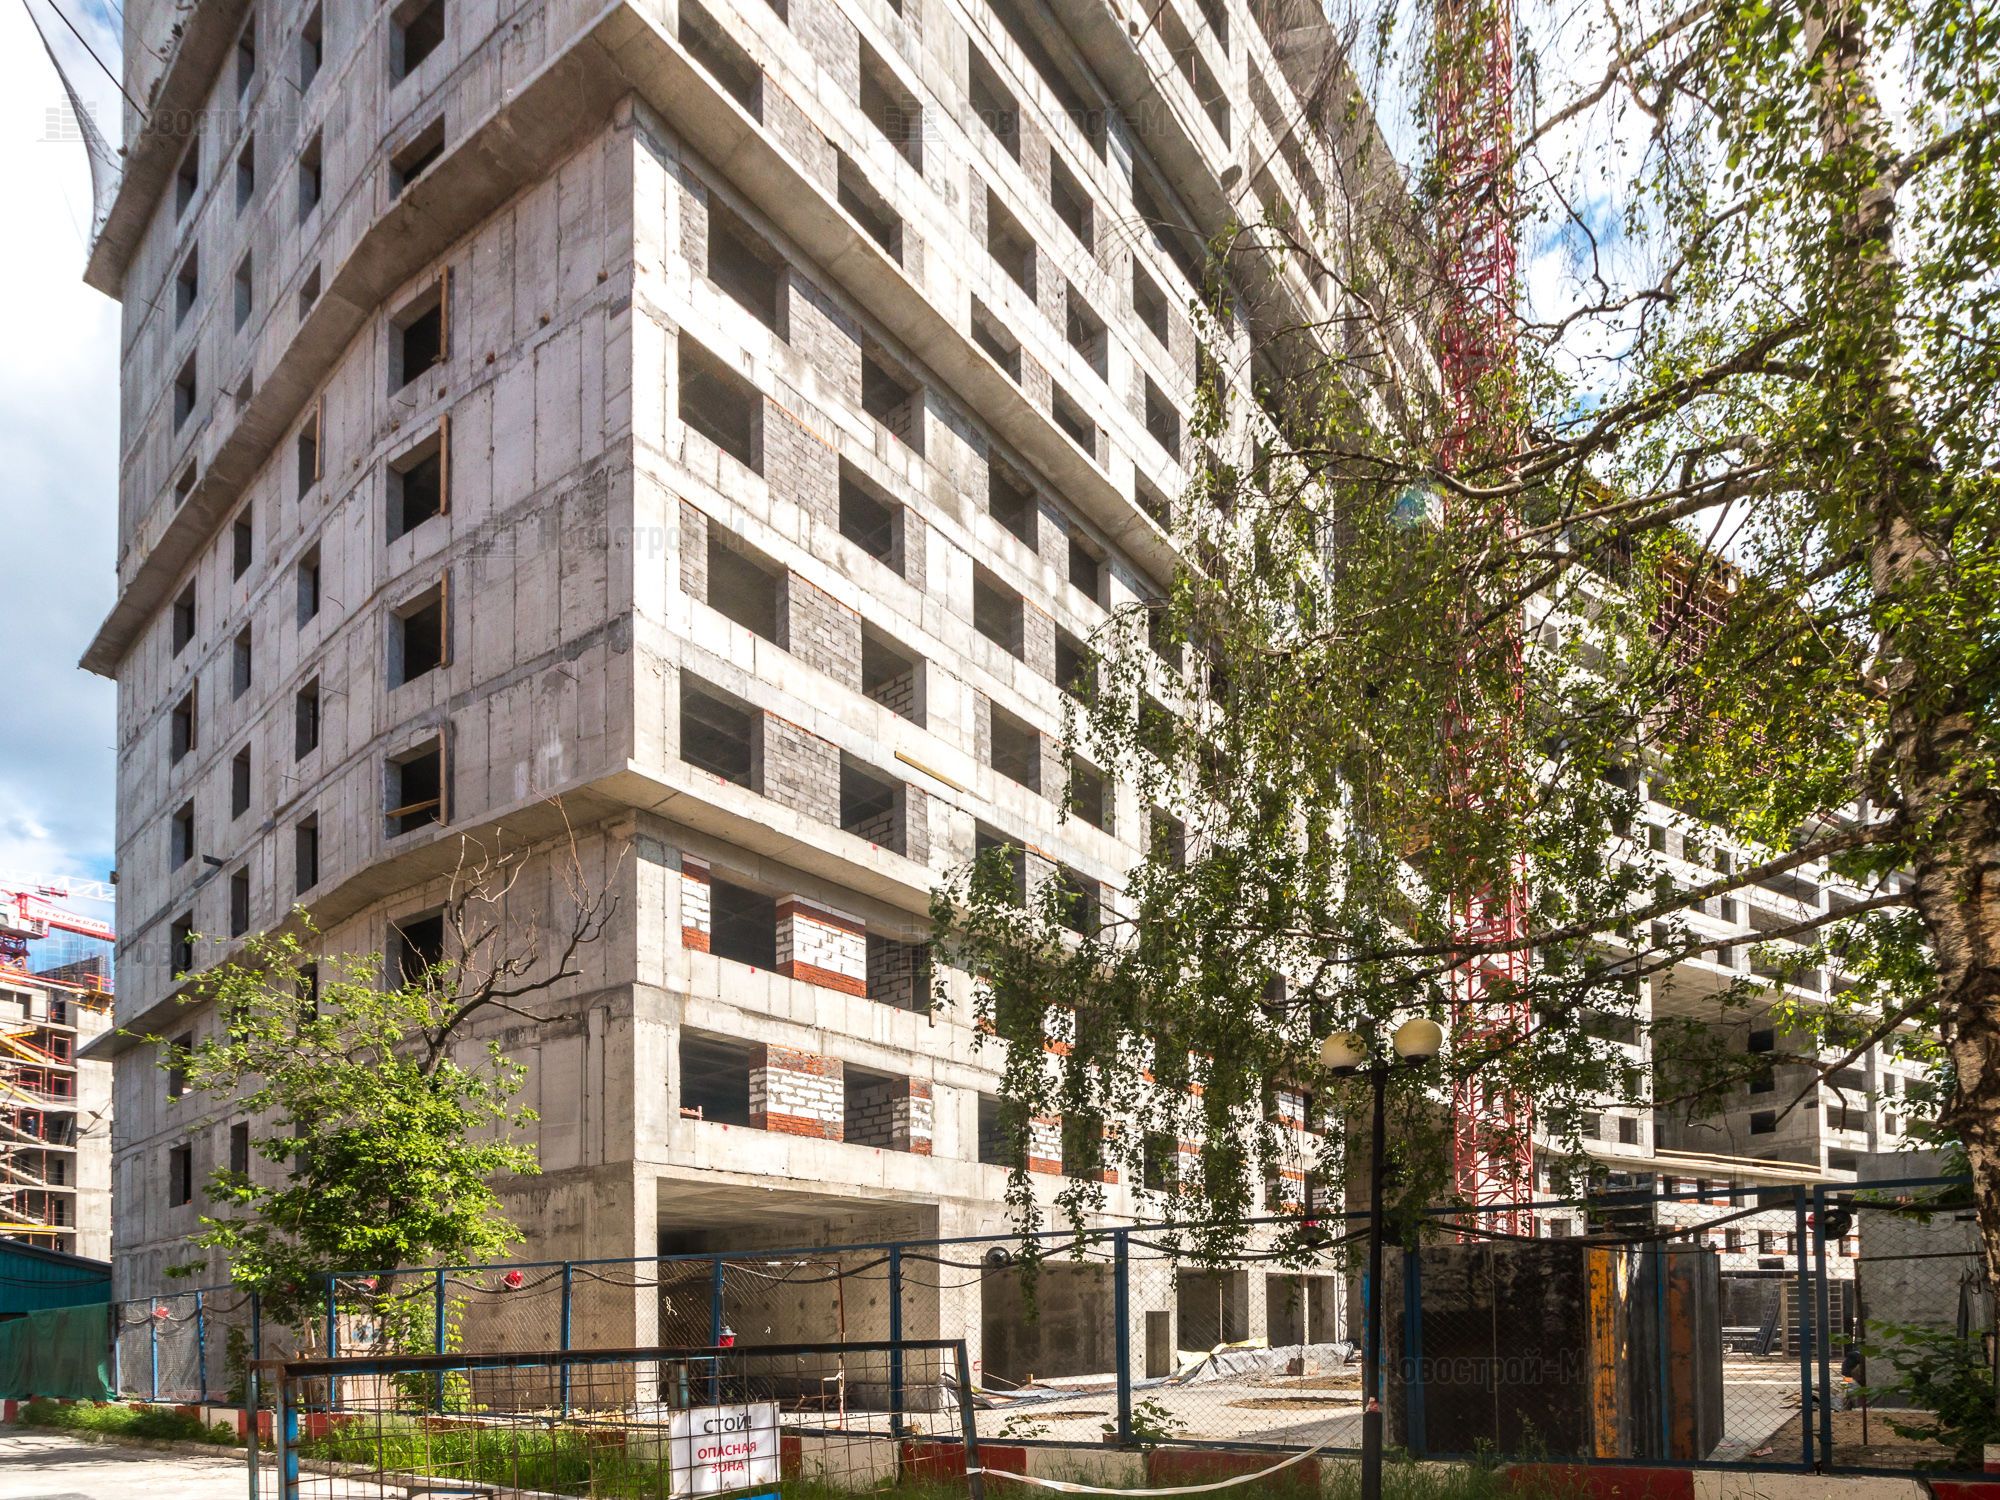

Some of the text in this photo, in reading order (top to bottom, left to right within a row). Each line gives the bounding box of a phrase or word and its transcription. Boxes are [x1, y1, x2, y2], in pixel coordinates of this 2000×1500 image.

[703, 1413, 752, 1434] СТОЙ!
[697, 1441, 757, 1460] ОПАСНАЯ
[711, 1461, 745, 1474] ЗОНА
